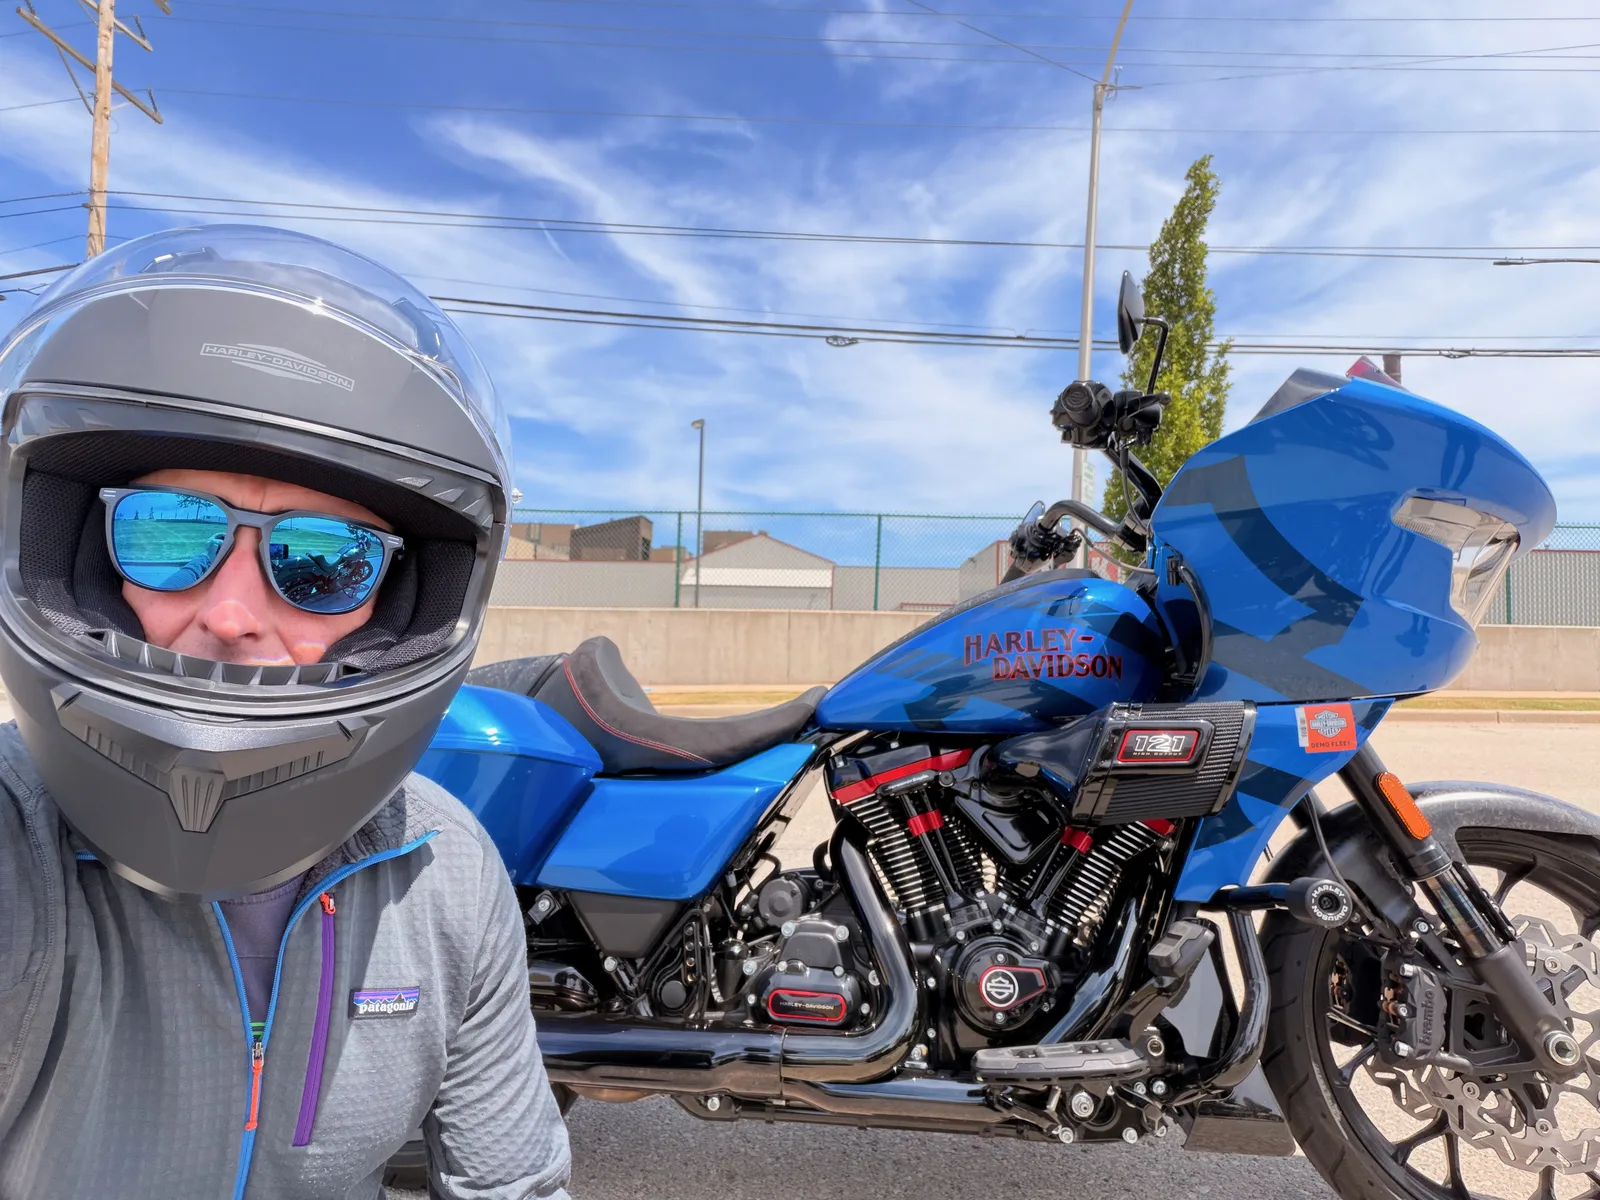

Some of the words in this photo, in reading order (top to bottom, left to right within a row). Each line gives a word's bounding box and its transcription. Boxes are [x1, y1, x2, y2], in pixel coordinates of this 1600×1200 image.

[963, 628, 1094, 667] HARLEY-
[992, 654, 1123, 681] DAVIDSON
[1134, 734, 1186, 752] 121
[358, 1001, 415, 1014] patagonia
[1419, 988, 1434, 1046] brembo
